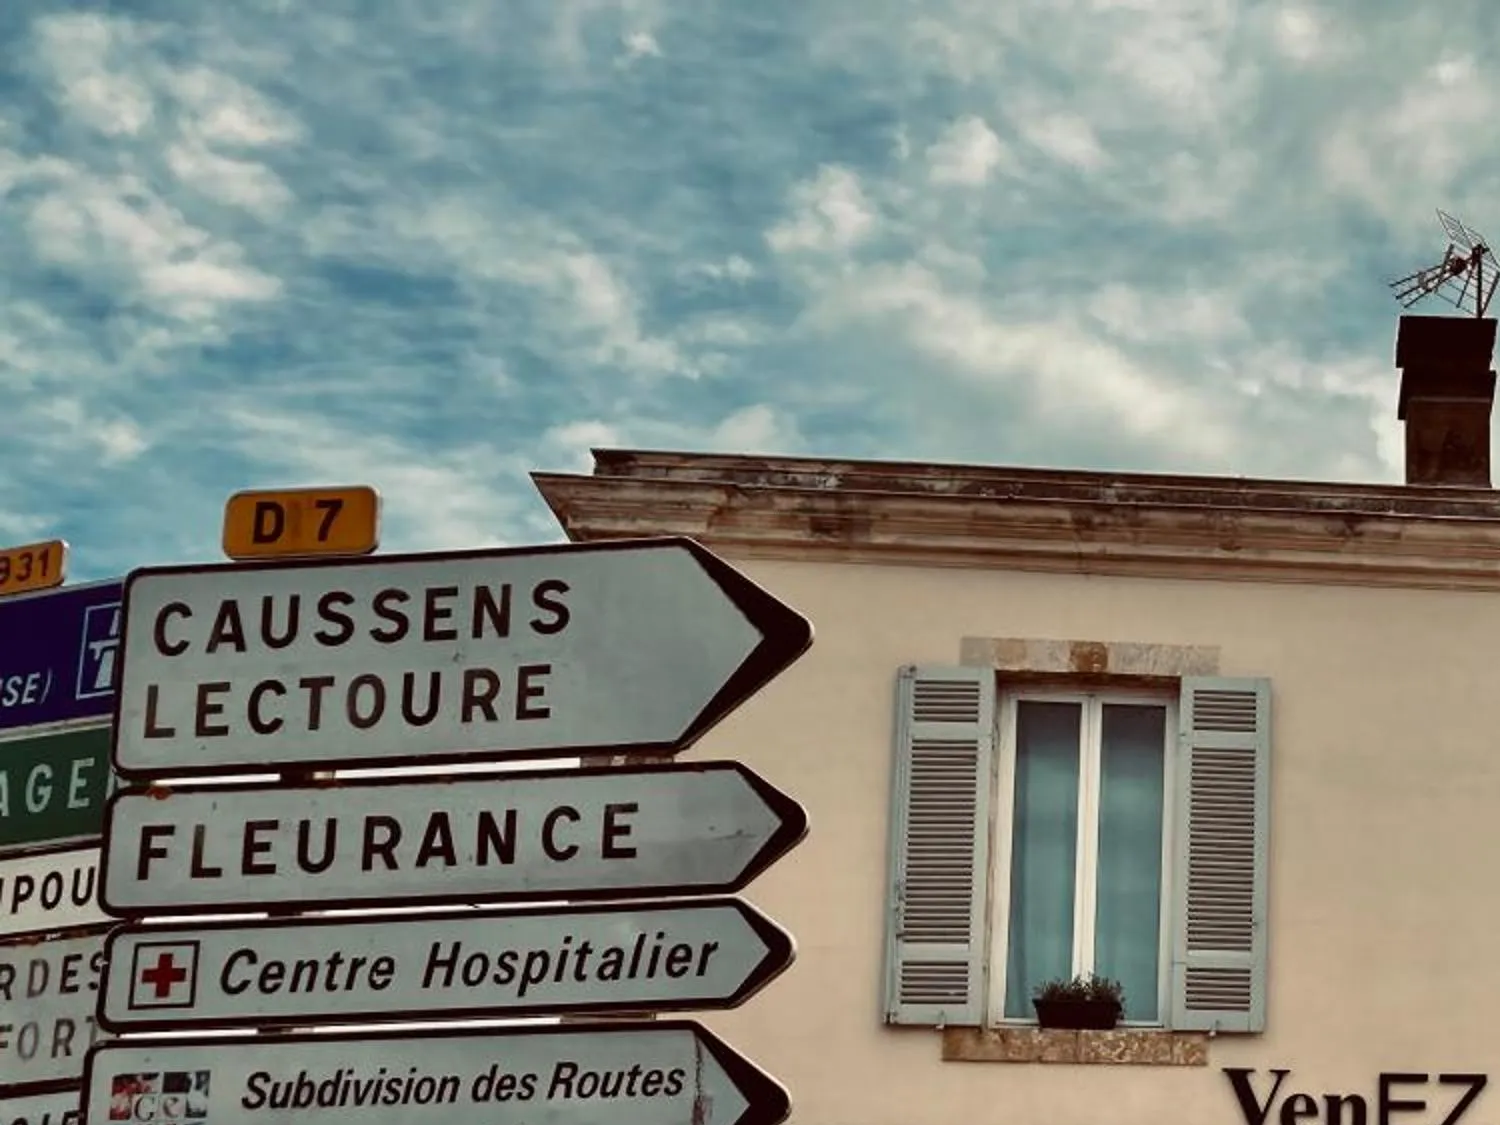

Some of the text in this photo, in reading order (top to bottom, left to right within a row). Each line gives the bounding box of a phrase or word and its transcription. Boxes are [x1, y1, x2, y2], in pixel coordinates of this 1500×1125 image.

[252, 499, 344, 544] D 7
[152, 579, 572, 657] CAUSSENS
[0, 668, 52, 707] SE)
[144, 664, 554, 740] LECTOURE
[135, 802, 640, 882] FLEURANCE
[0, 866, 95, 915] POU
[219, 933, 719, 1003] Centre Hospitalier
[241, 1060, 685, 1111] Subdivision des Routes
